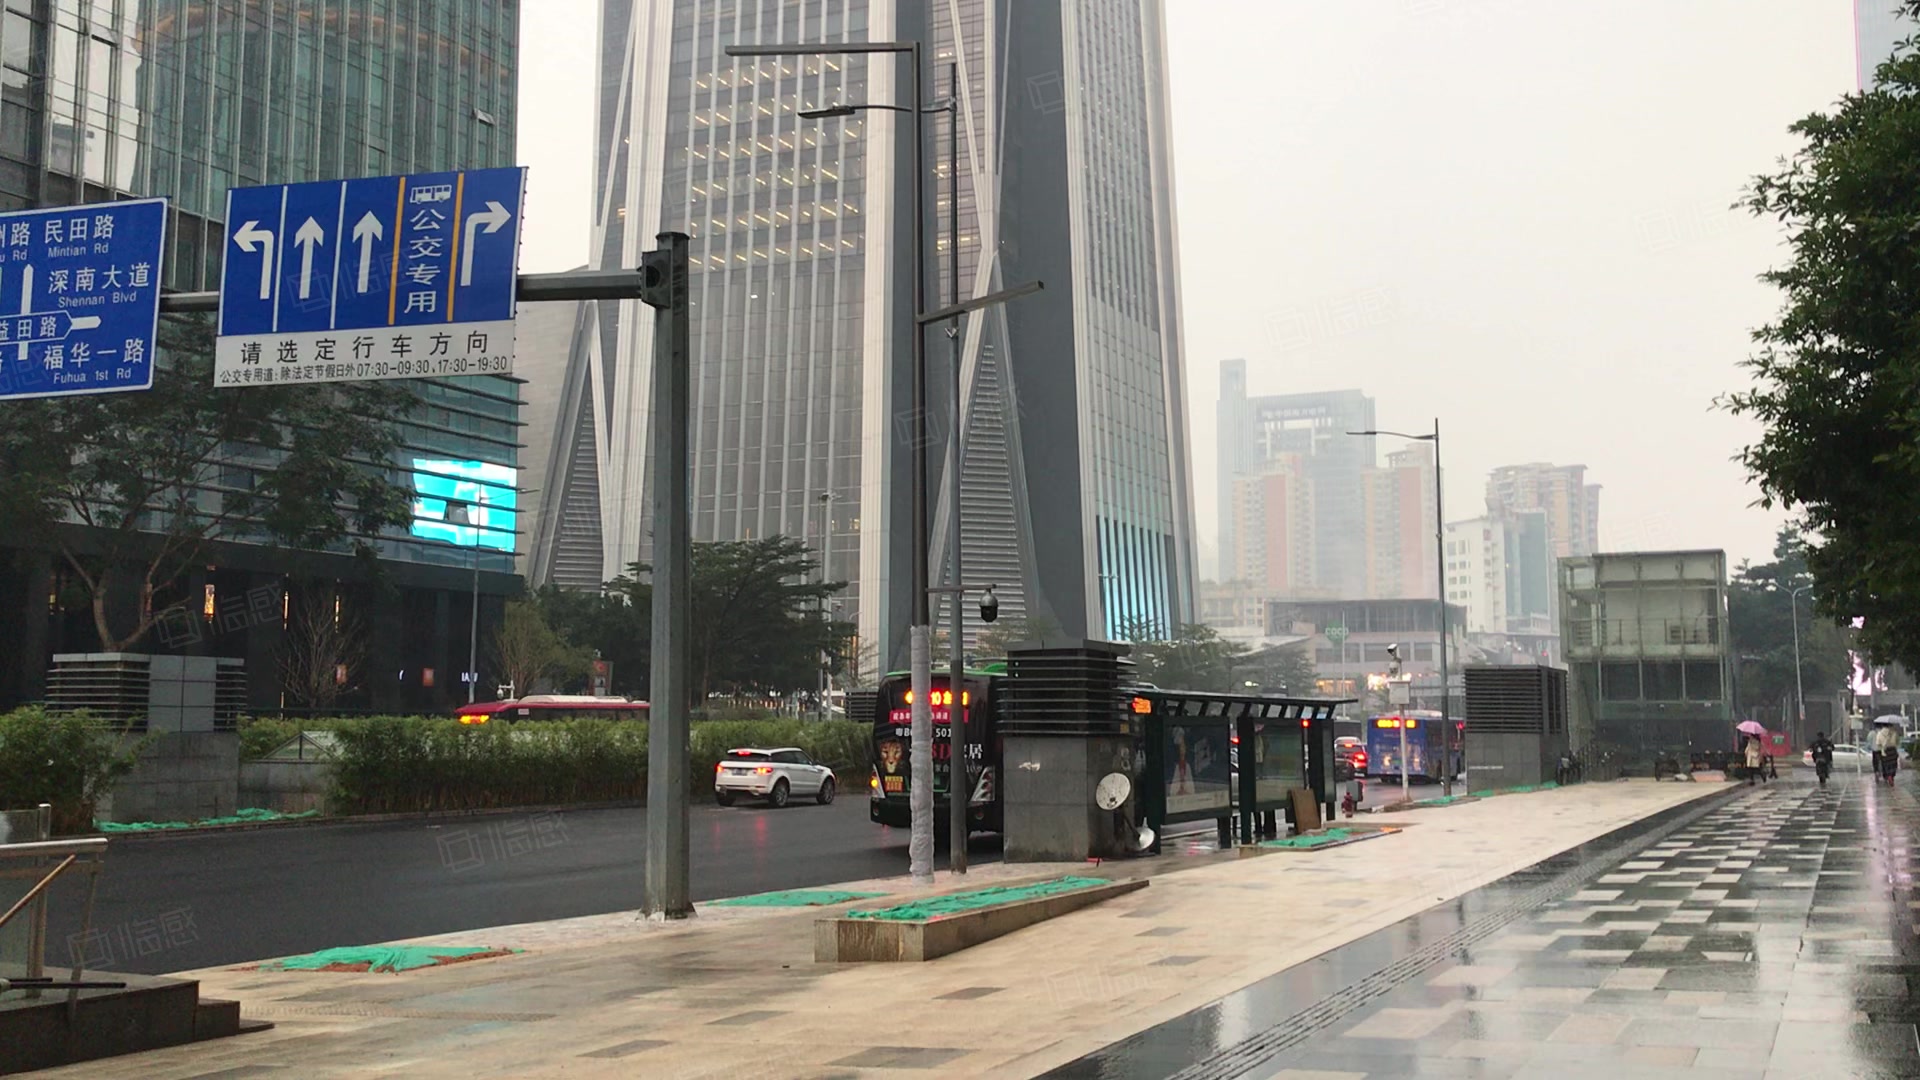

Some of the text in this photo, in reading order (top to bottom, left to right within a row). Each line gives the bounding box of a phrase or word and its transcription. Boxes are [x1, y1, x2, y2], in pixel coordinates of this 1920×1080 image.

[44, 214, 114, 244] 民田路
[12, 250, 27, 261] Rd
[48, 243, 109, 258] Mintian Rd
[404, 208, 446, 314] 公交专用
[48, 262, 151, 294] 深南大道
[58, 291, 137, 308] Shennan Blvd
[43, 338, 145, 370] 福华一路
[240, 330, 489, 366] 请选定行车方向
[53, 367, 132, 384] Fuhua 1st Rd
